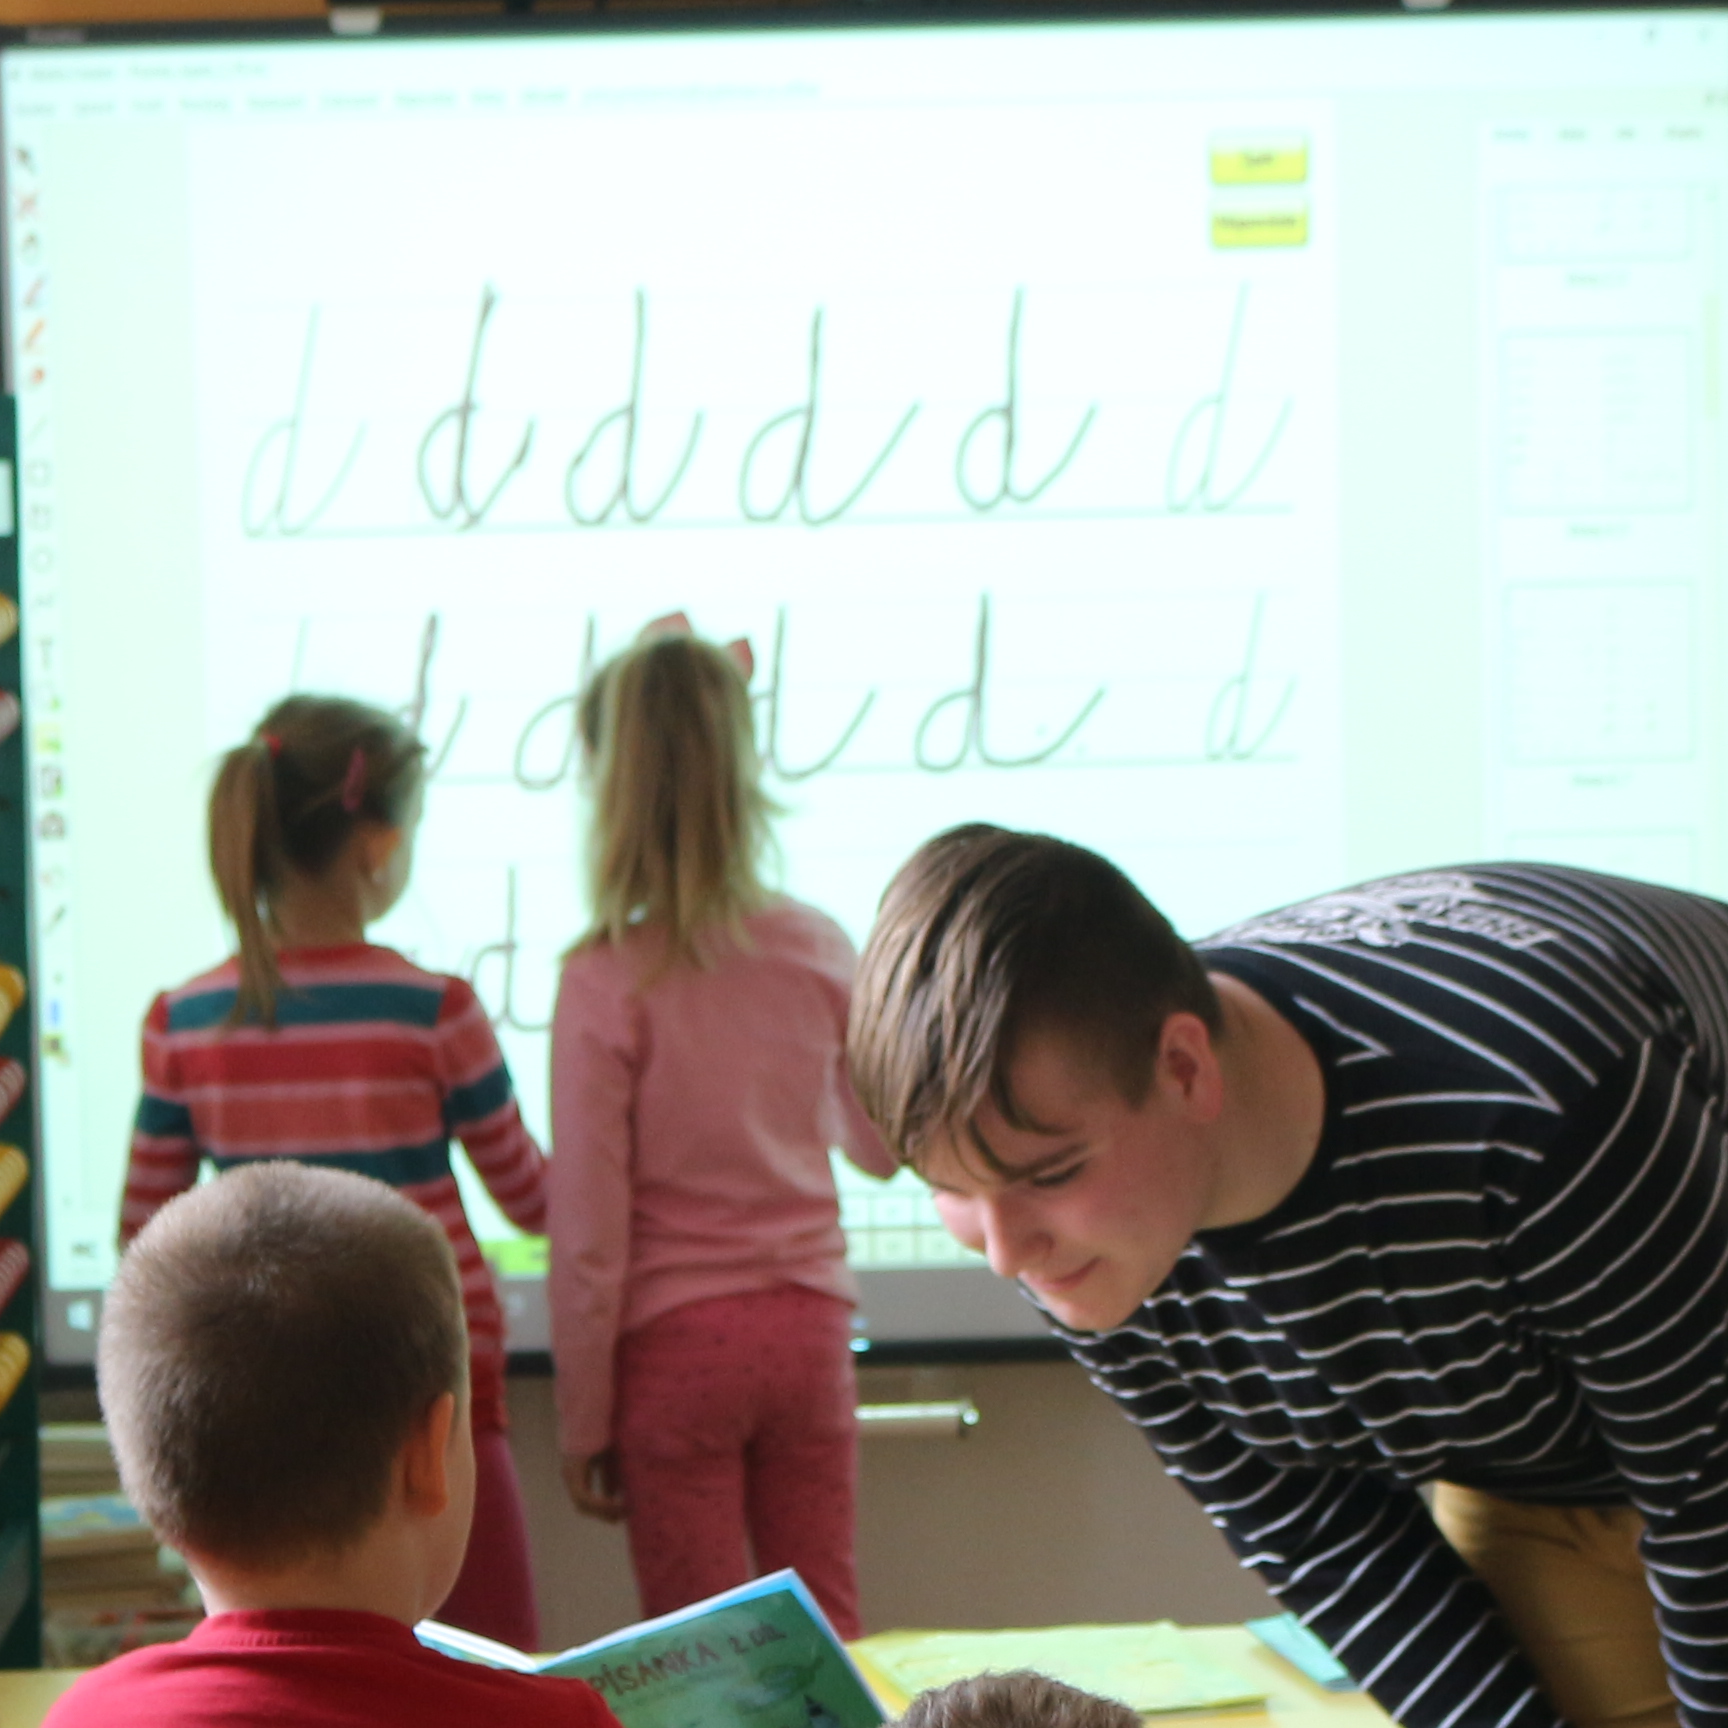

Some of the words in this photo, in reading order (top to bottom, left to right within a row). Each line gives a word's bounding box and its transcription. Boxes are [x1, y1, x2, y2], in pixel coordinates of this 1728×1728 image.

[416, 280, 536, 530] d
[564, 288, 705, 525] d
[739, 304, 923, 526] d
[955, 286, 1098, 511] d
[914, 592, 1108, 770] d
